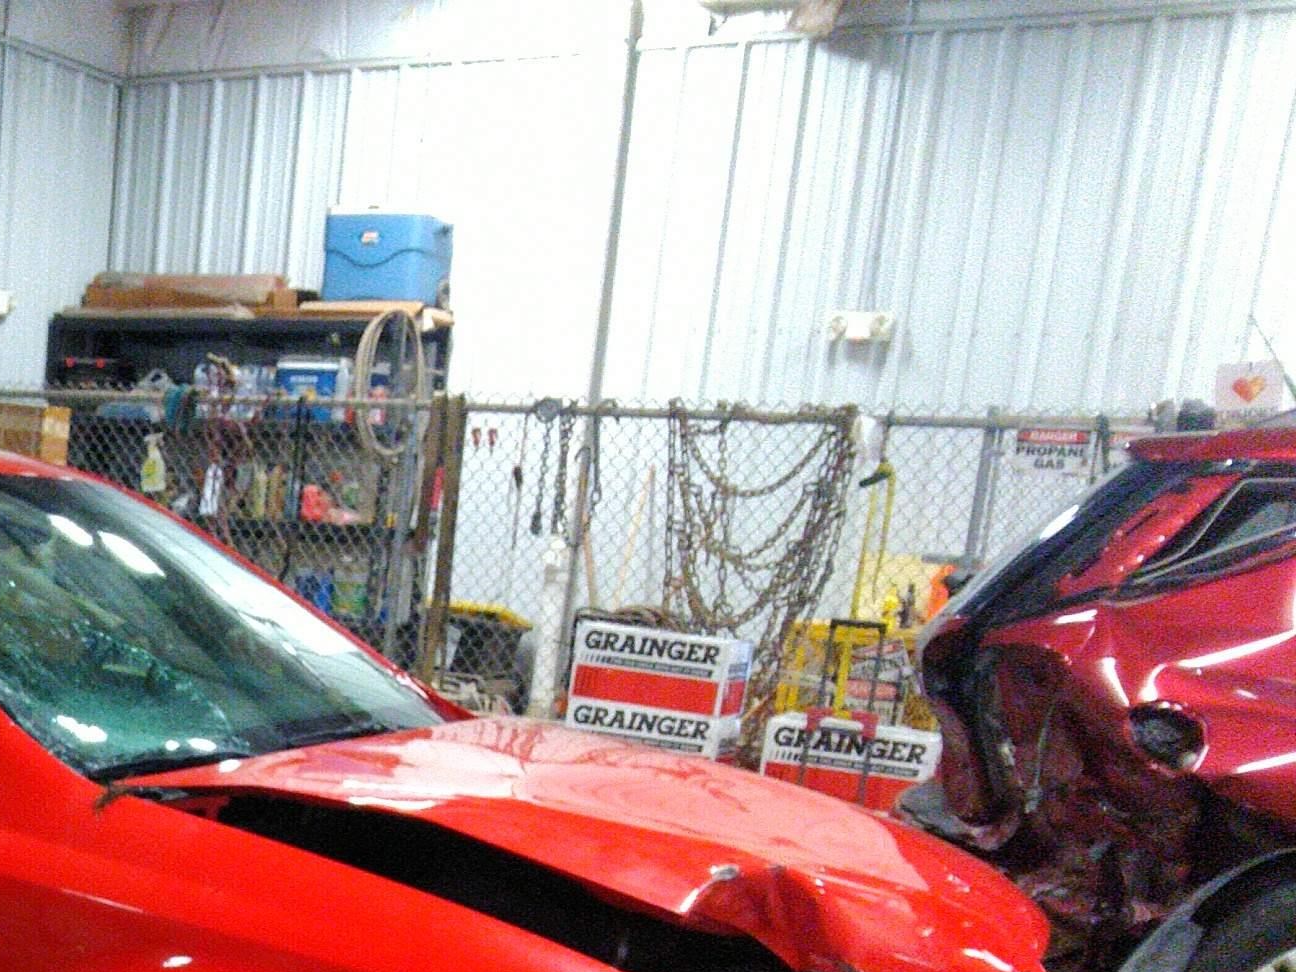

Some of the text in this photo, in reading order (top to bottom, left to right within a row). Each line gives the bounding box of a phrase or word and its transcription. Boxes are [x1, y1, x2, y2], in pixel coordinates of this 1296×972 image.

[1033, 458, 1065, 470] GAS
[585, 630, 720, 665] GRAINGER
[573, 705, 710, 740] GRAINGER
